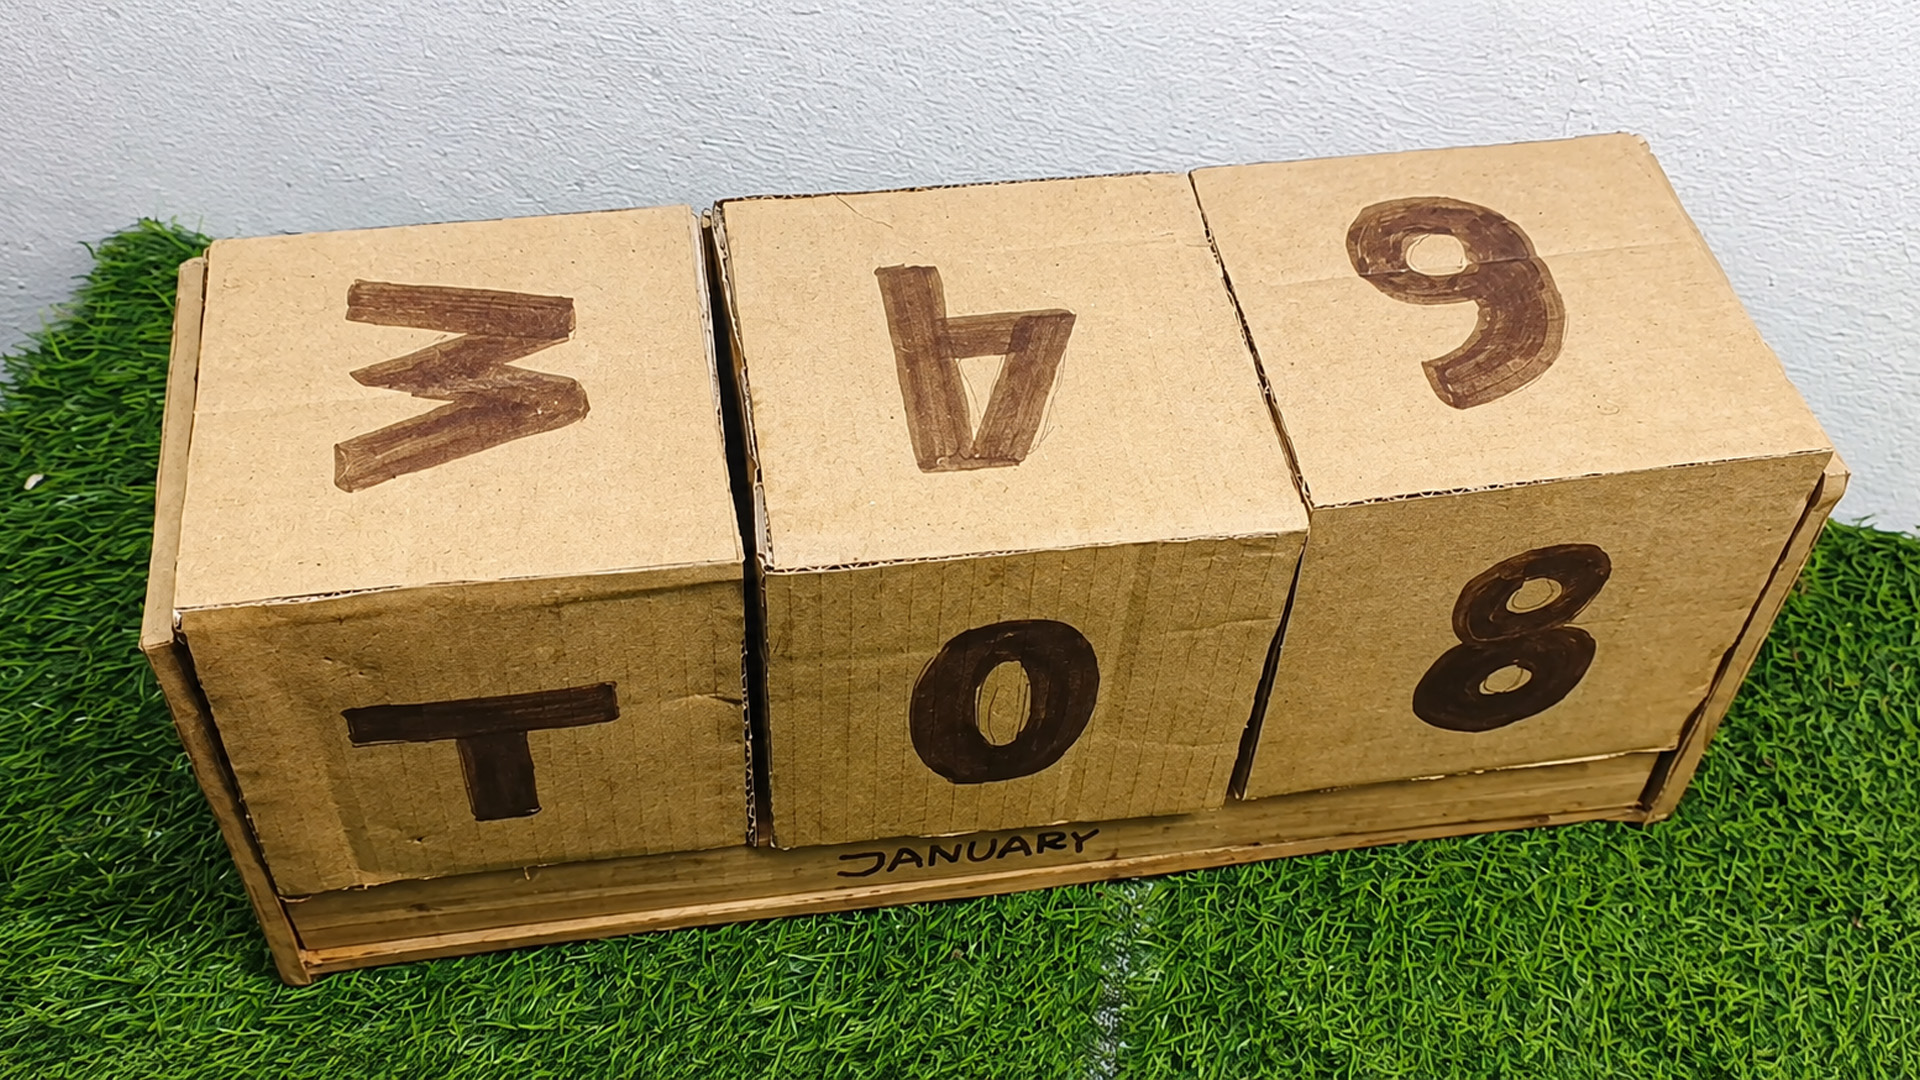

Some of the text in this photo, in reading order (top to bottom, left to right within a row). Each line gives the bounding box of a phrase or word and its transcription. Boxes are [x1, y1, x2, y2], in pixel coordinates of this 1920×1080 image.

[876, 264, 1077, 471] 4
[1413, 544, 1611, 732] 8
[343, 681, 619, 821] T
[837, 828, 1099, 877] JANUARY
